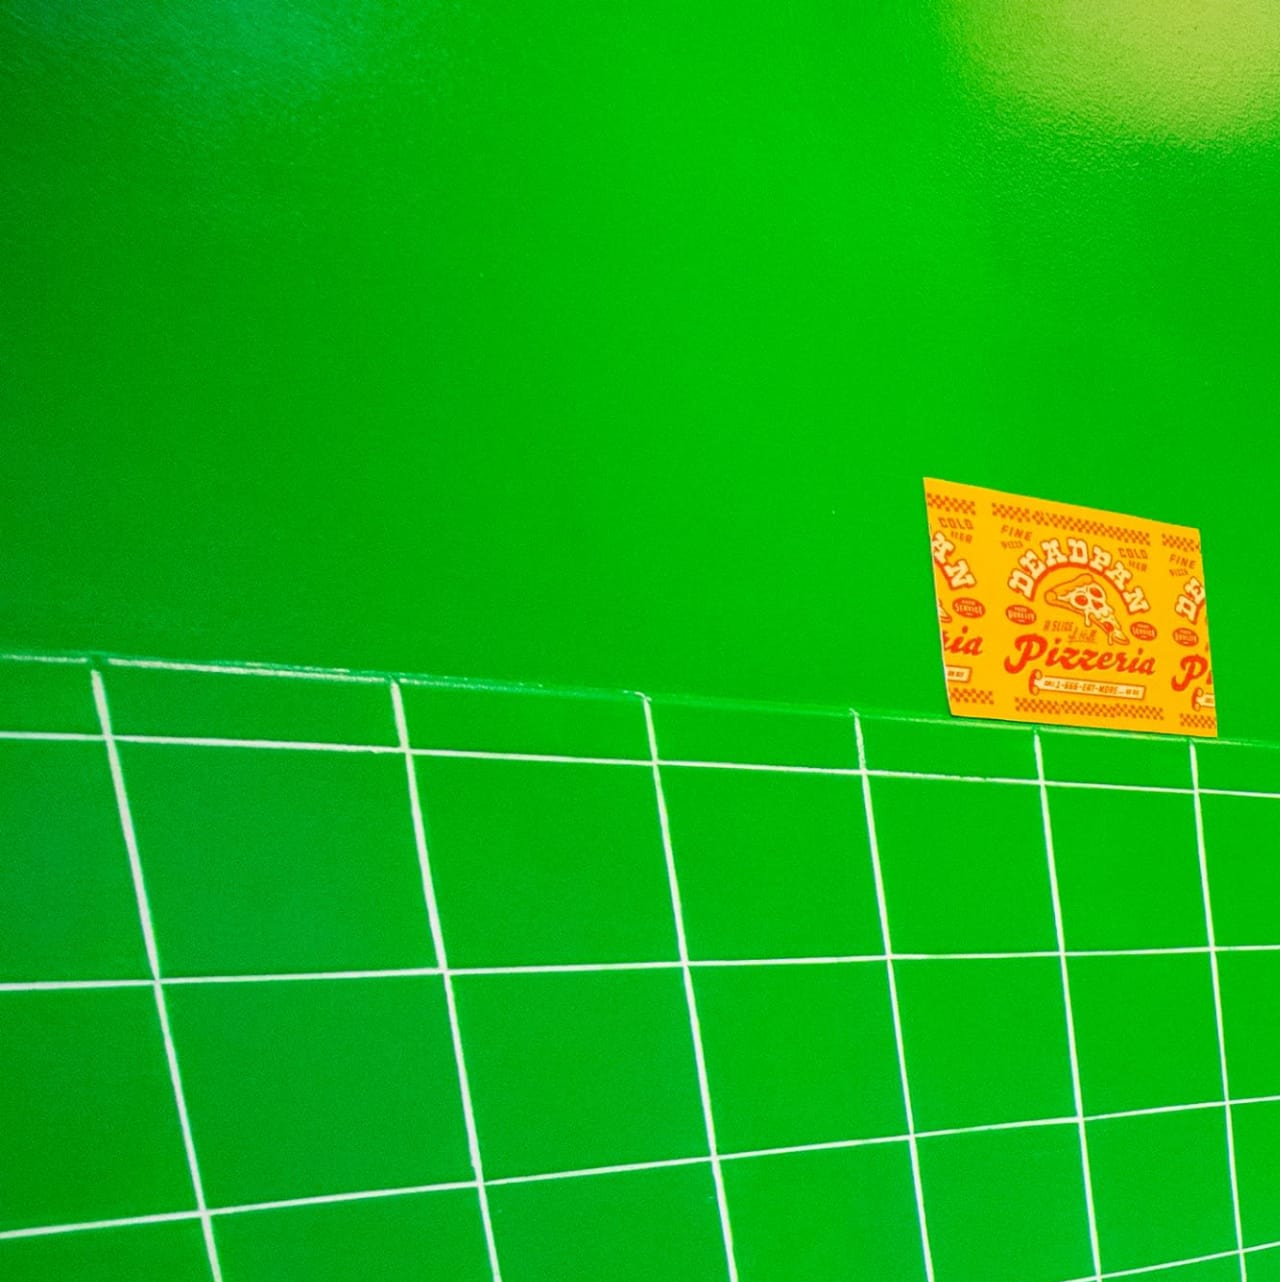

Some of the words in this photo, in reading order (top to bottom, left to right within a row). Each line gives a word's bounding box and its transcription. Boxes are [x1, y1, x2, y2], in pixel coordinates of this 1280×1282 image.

[938, 517, 974, 530] COLD
[1001, 525, 1032, 541] FINE
[1119, 547, 1149, 560] COLD
[1169, 553, 1197, 569] FINE
[1007, 536, 1151, 617] DEADPAN
[1004, 633, 1156, 676] Pizzeria
